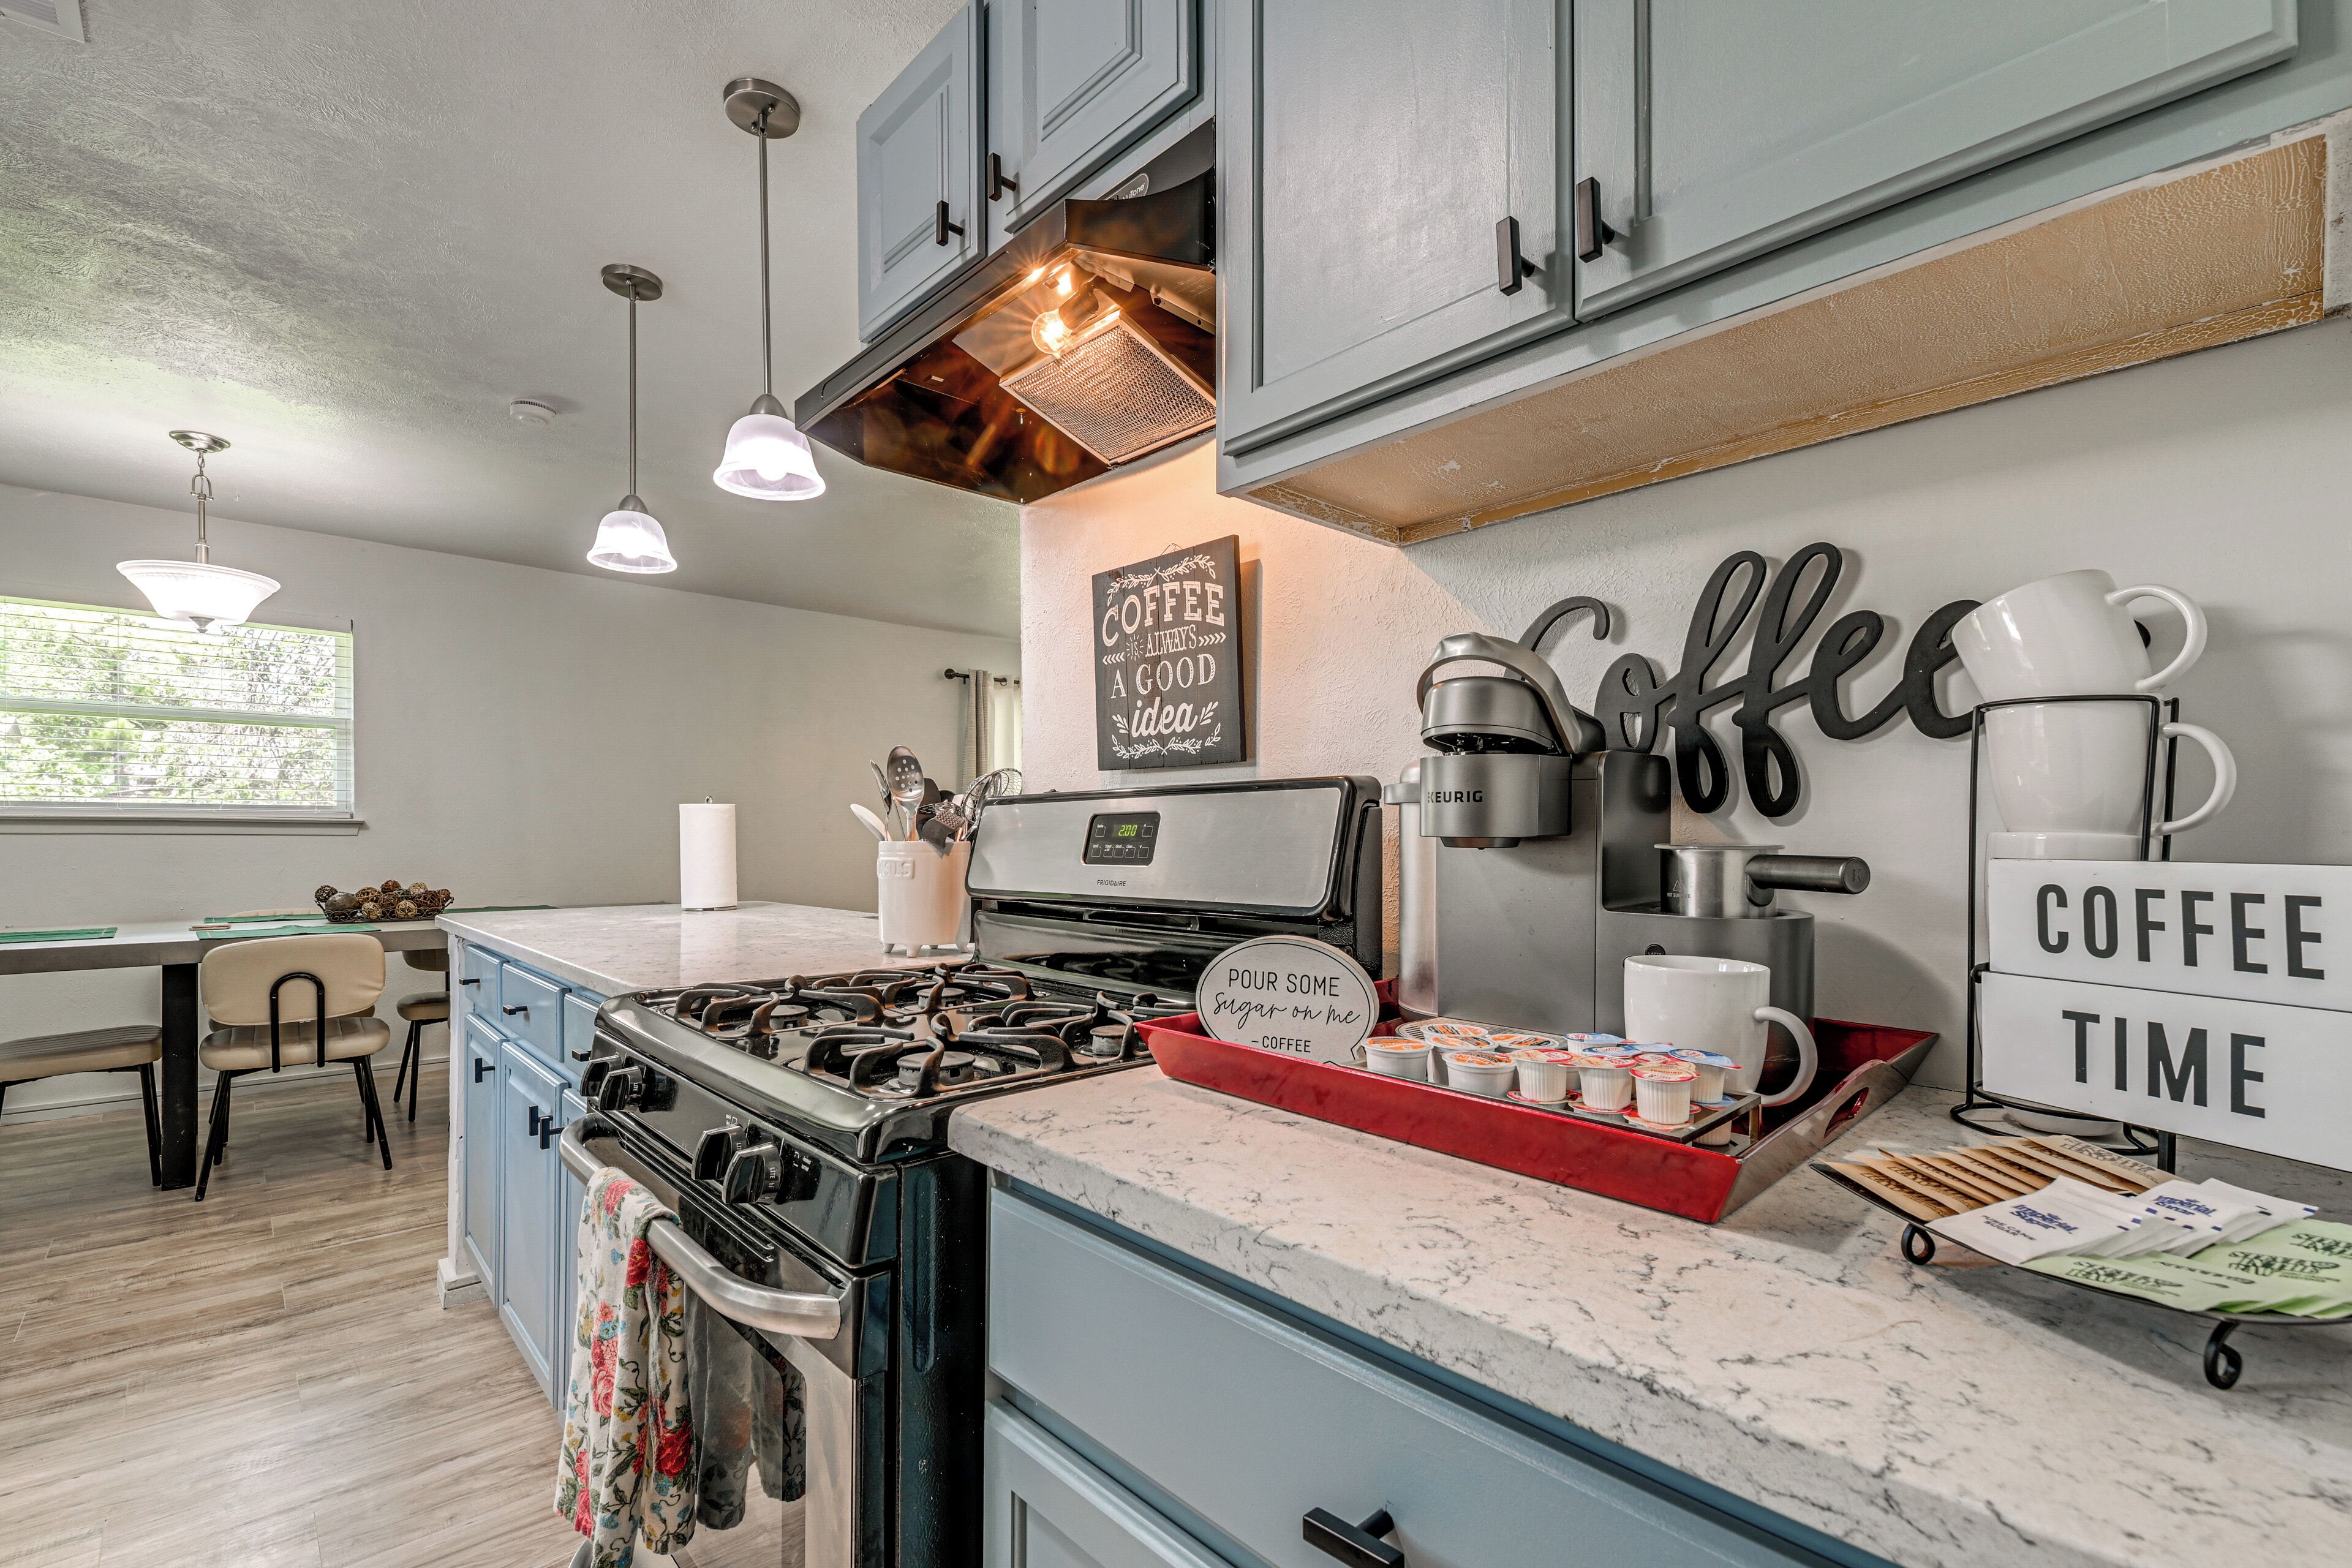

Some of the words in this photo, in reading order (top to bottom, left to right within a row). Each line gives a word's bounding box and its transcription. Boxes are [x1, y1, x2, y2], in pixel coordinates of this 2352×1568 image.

[1102, 581, 1224, 647] COFFEE
[1145, 624, 1197, 658] ALWAYS
[1110, 668, 1127, 699] A
[1136, 653, 1216, 695] GOOD
[1131, 696, 1199, 738] idea
[1427, 790, 1483, 804] KEURIG
[2036, 883, 2326, 981] COFFEE
[1228, 968, 1278, 992] POUR
[1286, 973, 1340, 997] SOME
[1292, 1005, 1322, 1020] on
[1325, 1004, 1361, 1025] me
[2062, 1009, 2266, 1119] TIME
[2010, 1204, 2079, 1232] Imperial
[2153, 1195, 2218, 1215] Imperial
[1983, 1219, 2019, 1237] SUGAR
[2007, 1226, 2038, 1241] CANE
[2010, 1210, 2057, 1230] Sugar
